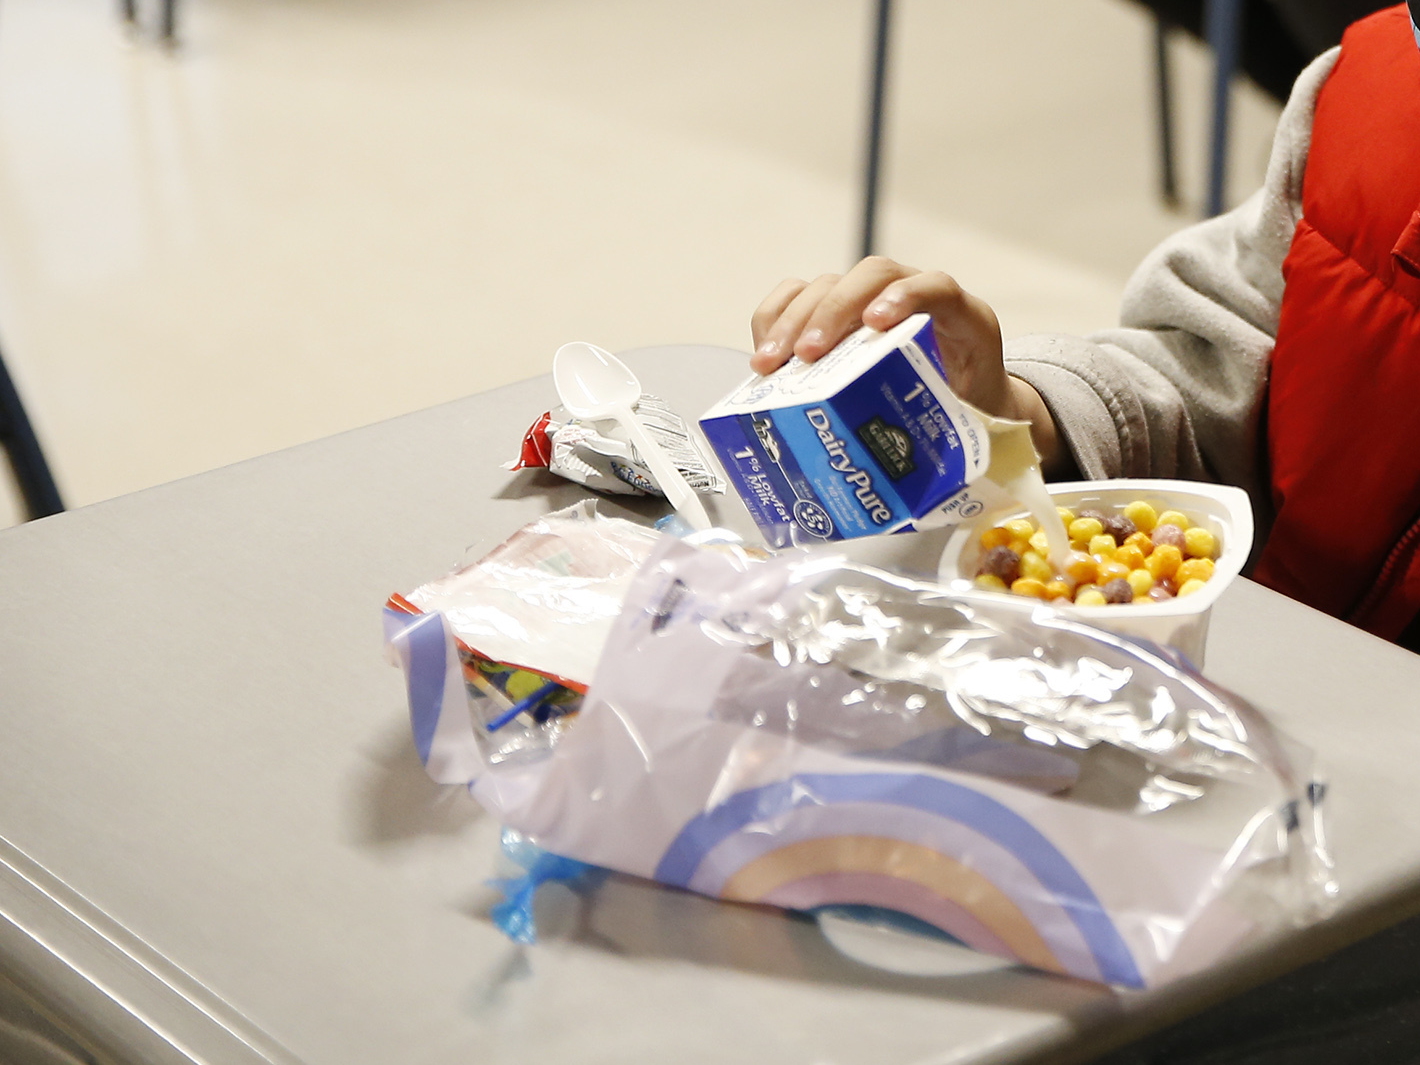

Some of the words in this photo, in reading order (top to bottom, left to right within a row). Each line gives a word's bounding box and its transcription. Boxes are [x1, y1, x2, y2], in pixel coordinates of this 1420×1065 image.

[904, 381, 930, 407] 1%
[929, 404, 959, 450] Lowfat
[918, 413, 940, 441] Milk
[805, 408, 891, 525] DairyPure
[735, 445, 761, 472] 1%
[758, 473, 790, 522] Lowfat
[748, 475, 770, 506] Milk
[808, 513, 817, 525] 5
[941, 499, 960, 514] PUSH
[960, 493, 969, 501] UP
